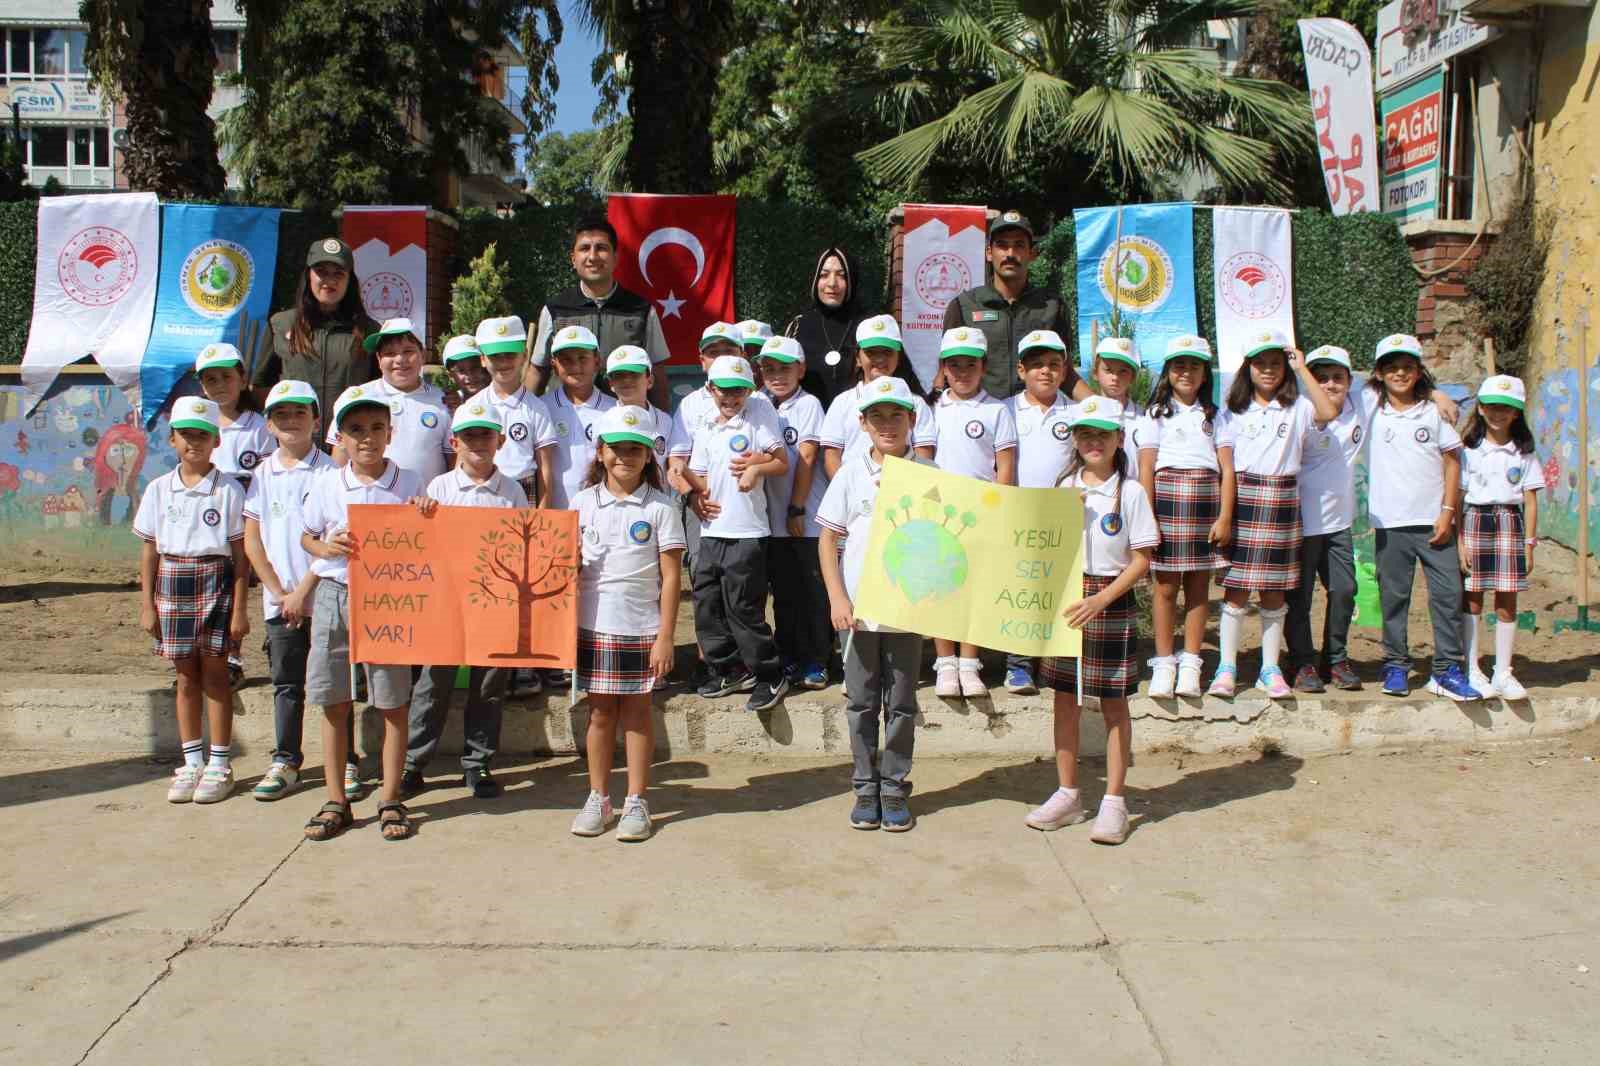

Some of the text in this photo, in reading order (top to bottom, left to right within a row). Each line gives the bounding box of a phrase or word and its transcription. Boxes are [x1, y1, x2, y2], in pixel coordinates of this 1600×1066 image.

[1386, 104, 1439, 156] ÇAĞRI
[363, 527, 426, 554] AĞAÇ
[363, 563, 435, 582] VARSA
[1015, 560, 1054, 579] SEV
[363, 594, 428, 613] HAYAT
[364, 624, 414, 648] VAR!
[1000, 619, 1053, 640] KORU
